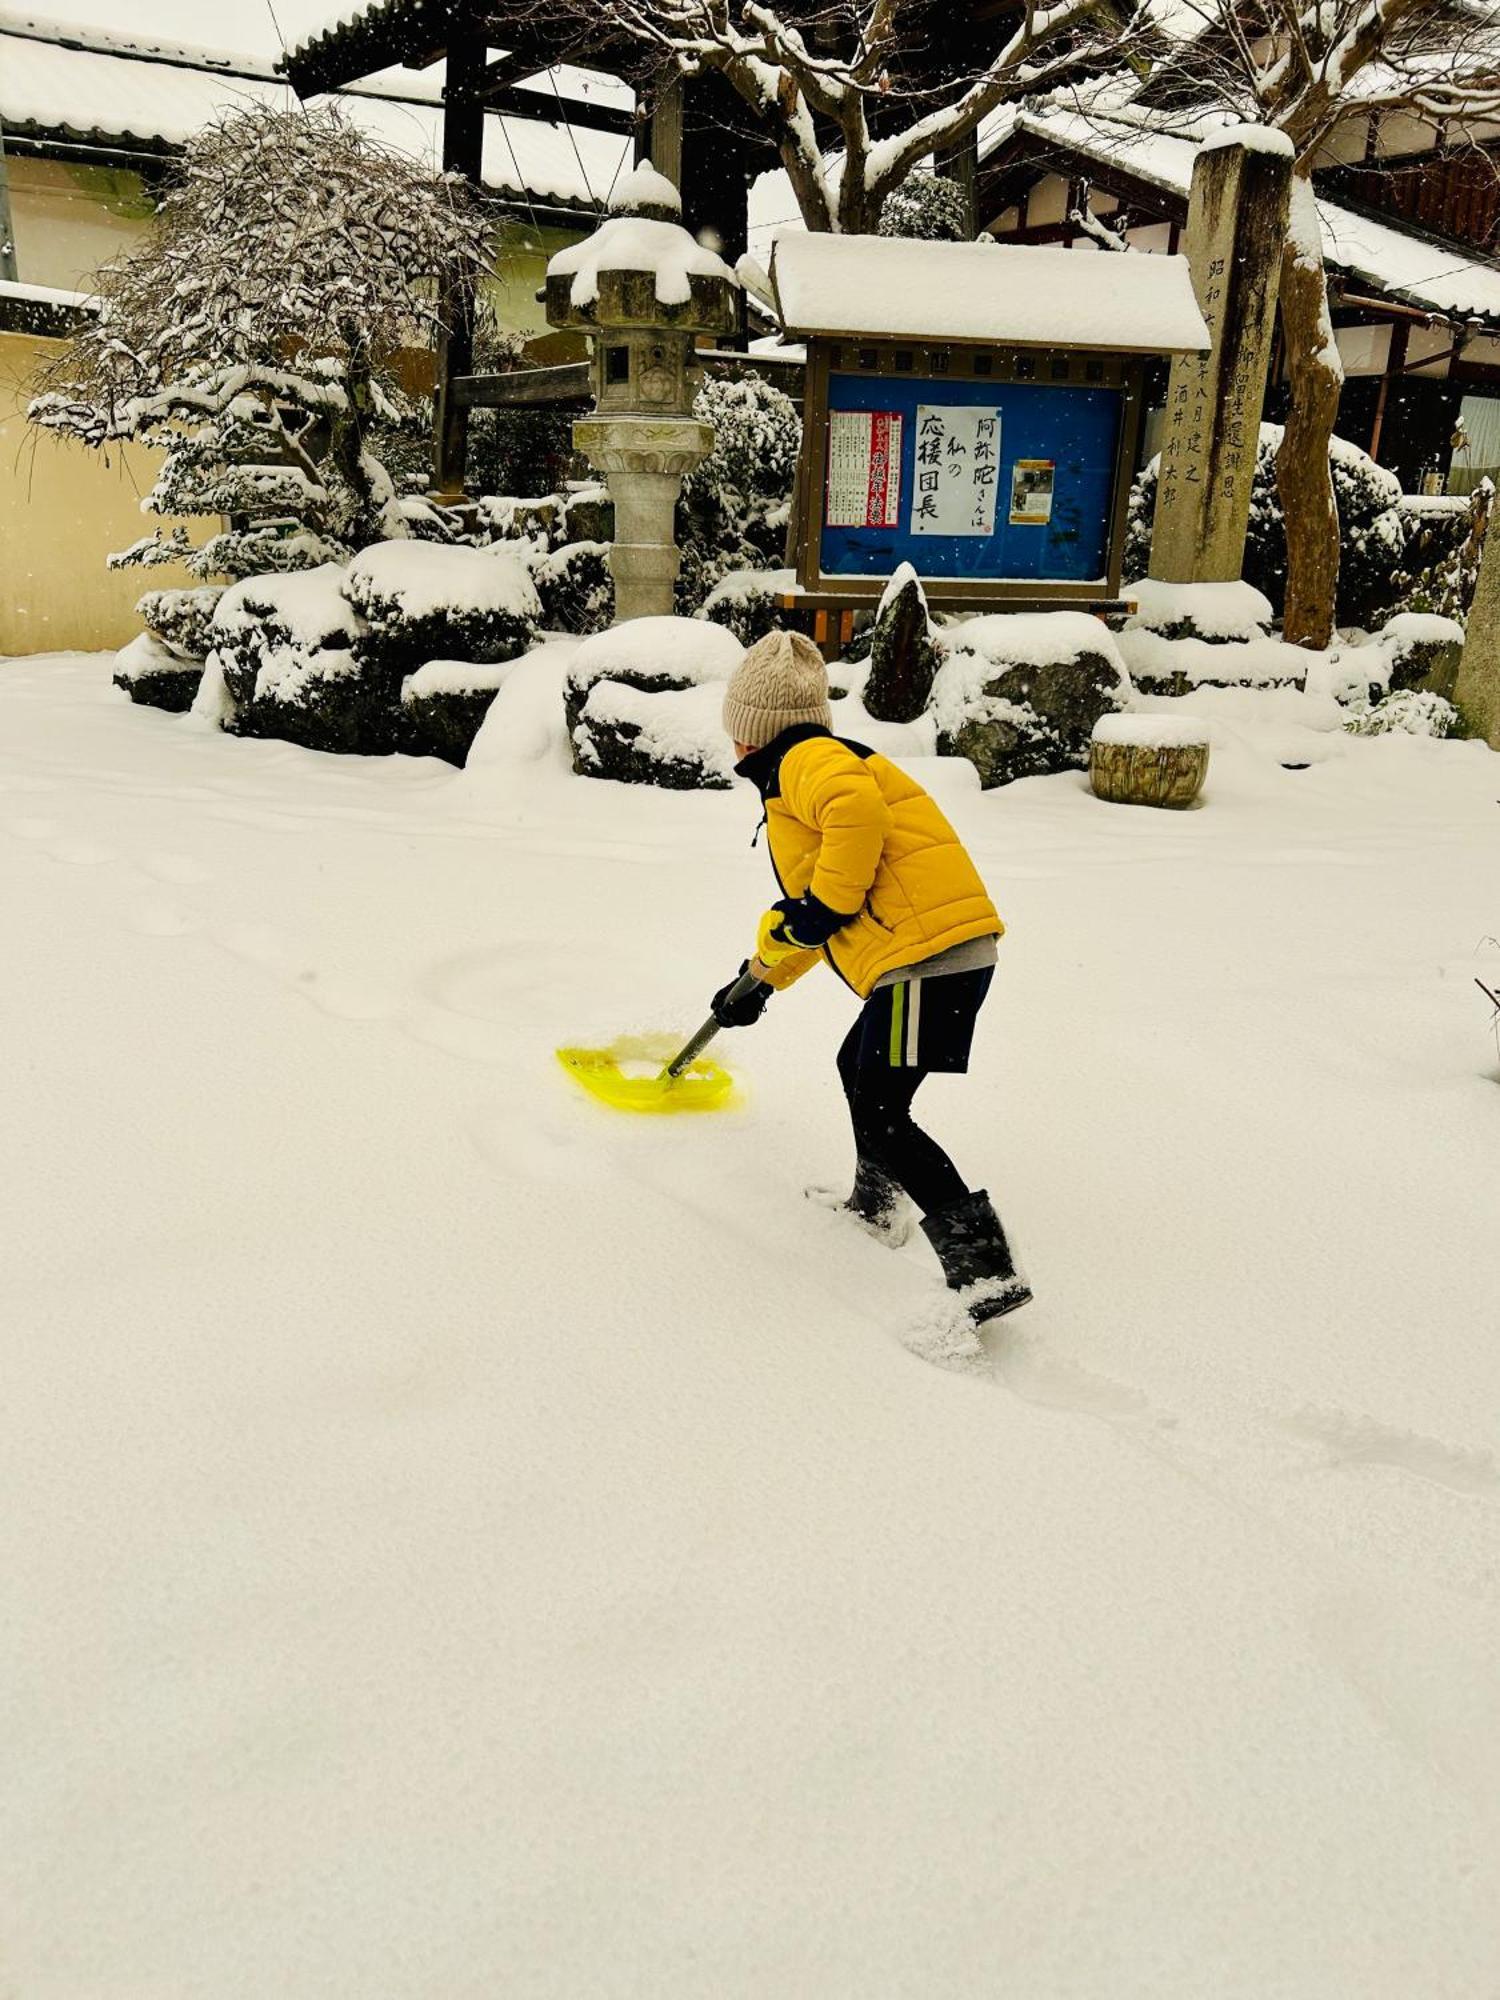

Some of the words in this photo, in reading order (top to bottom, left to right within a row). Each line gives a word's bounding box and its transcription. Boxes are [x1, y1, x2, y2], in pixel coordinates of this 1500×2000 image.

[912, 415, 945, 519] 応援団長
[947, 436, 967, 478] 私の
[971, 418, 997, 527] 阿弥陀さんは
